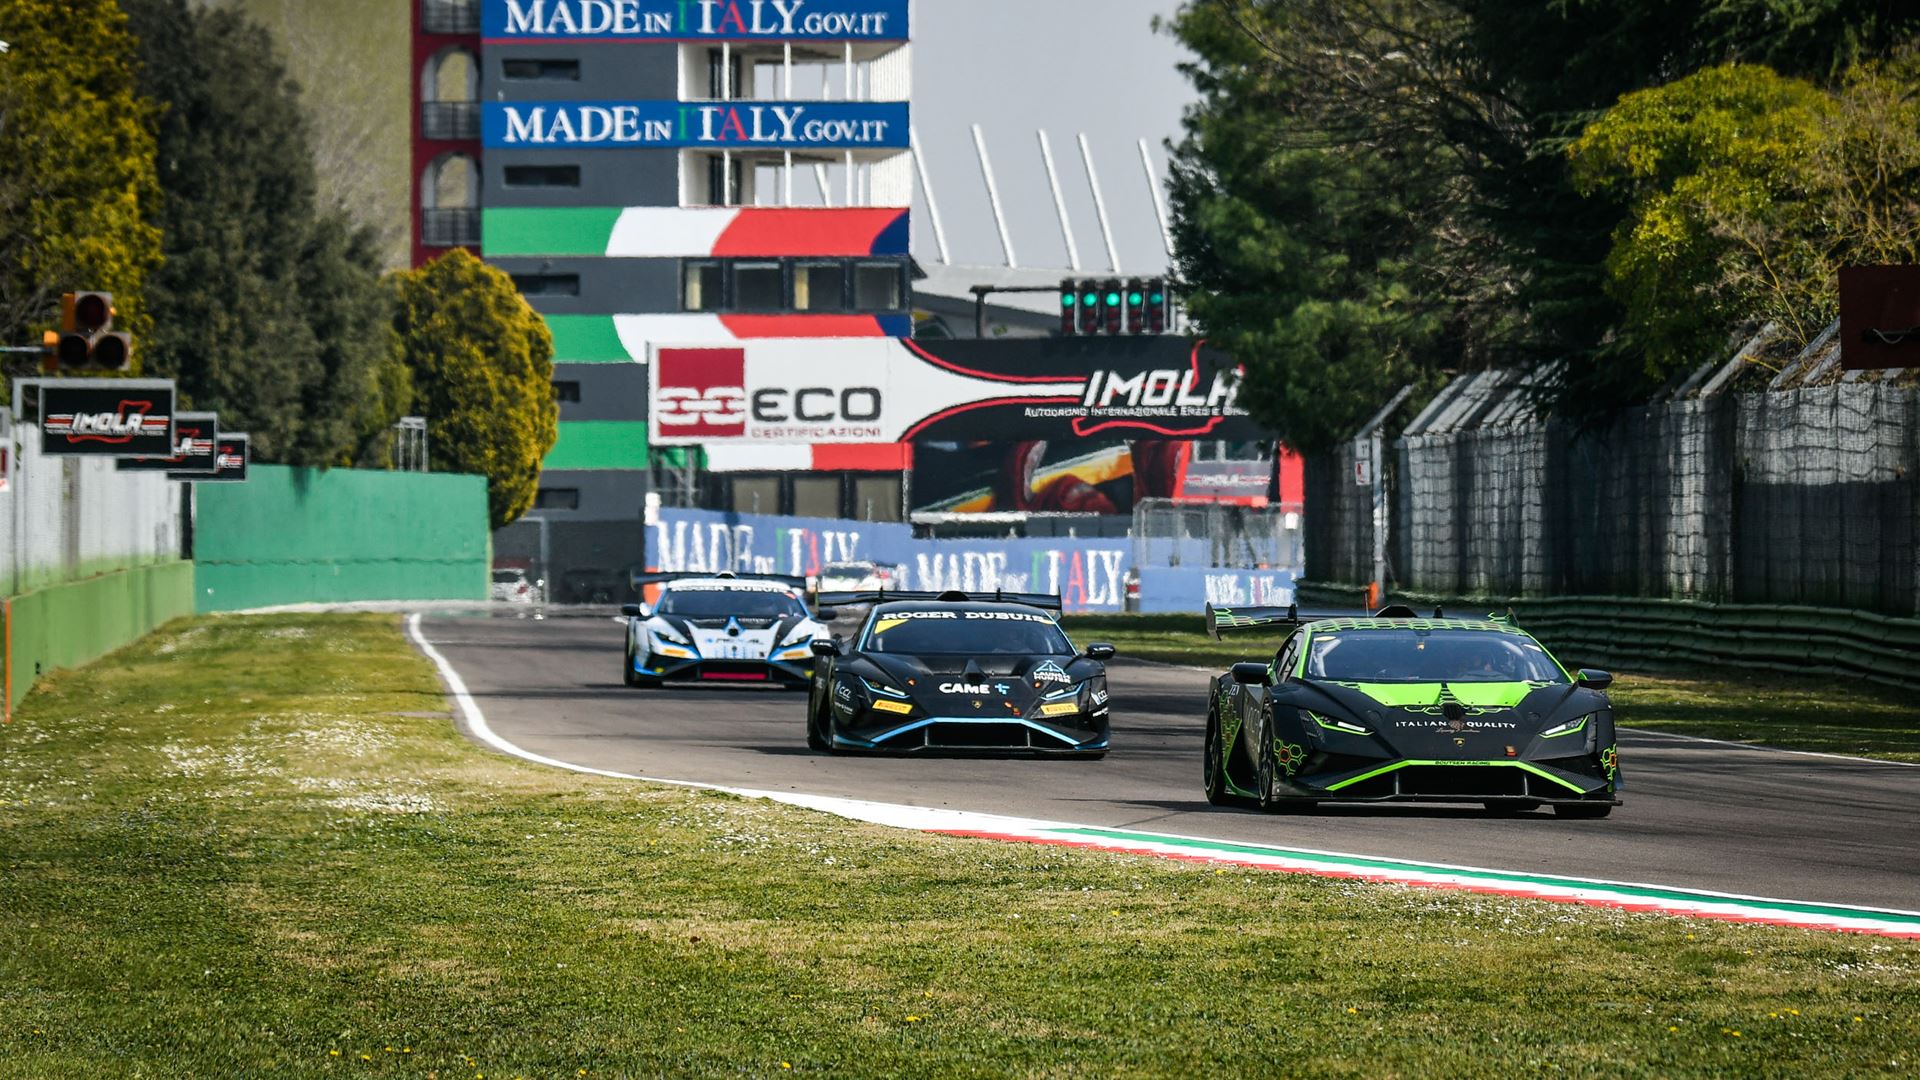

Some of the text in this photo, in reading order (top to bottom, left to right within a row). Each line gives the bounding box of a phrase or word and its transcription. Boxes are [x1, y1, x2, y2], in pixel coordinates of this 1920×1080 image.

[1083, 369, 1240, 407] IMOLA
[752, 387, 882, 422] ECO
[72, 411, 143, 431] IMOLA
[751, 427, 881, 438] CERTIFICAZIONI
[881, 610, 1046, 623] ROGER DUBUIS
[938, 682, 991, 695] CAME
[1466, 720, 1517, 729] QUALITY
